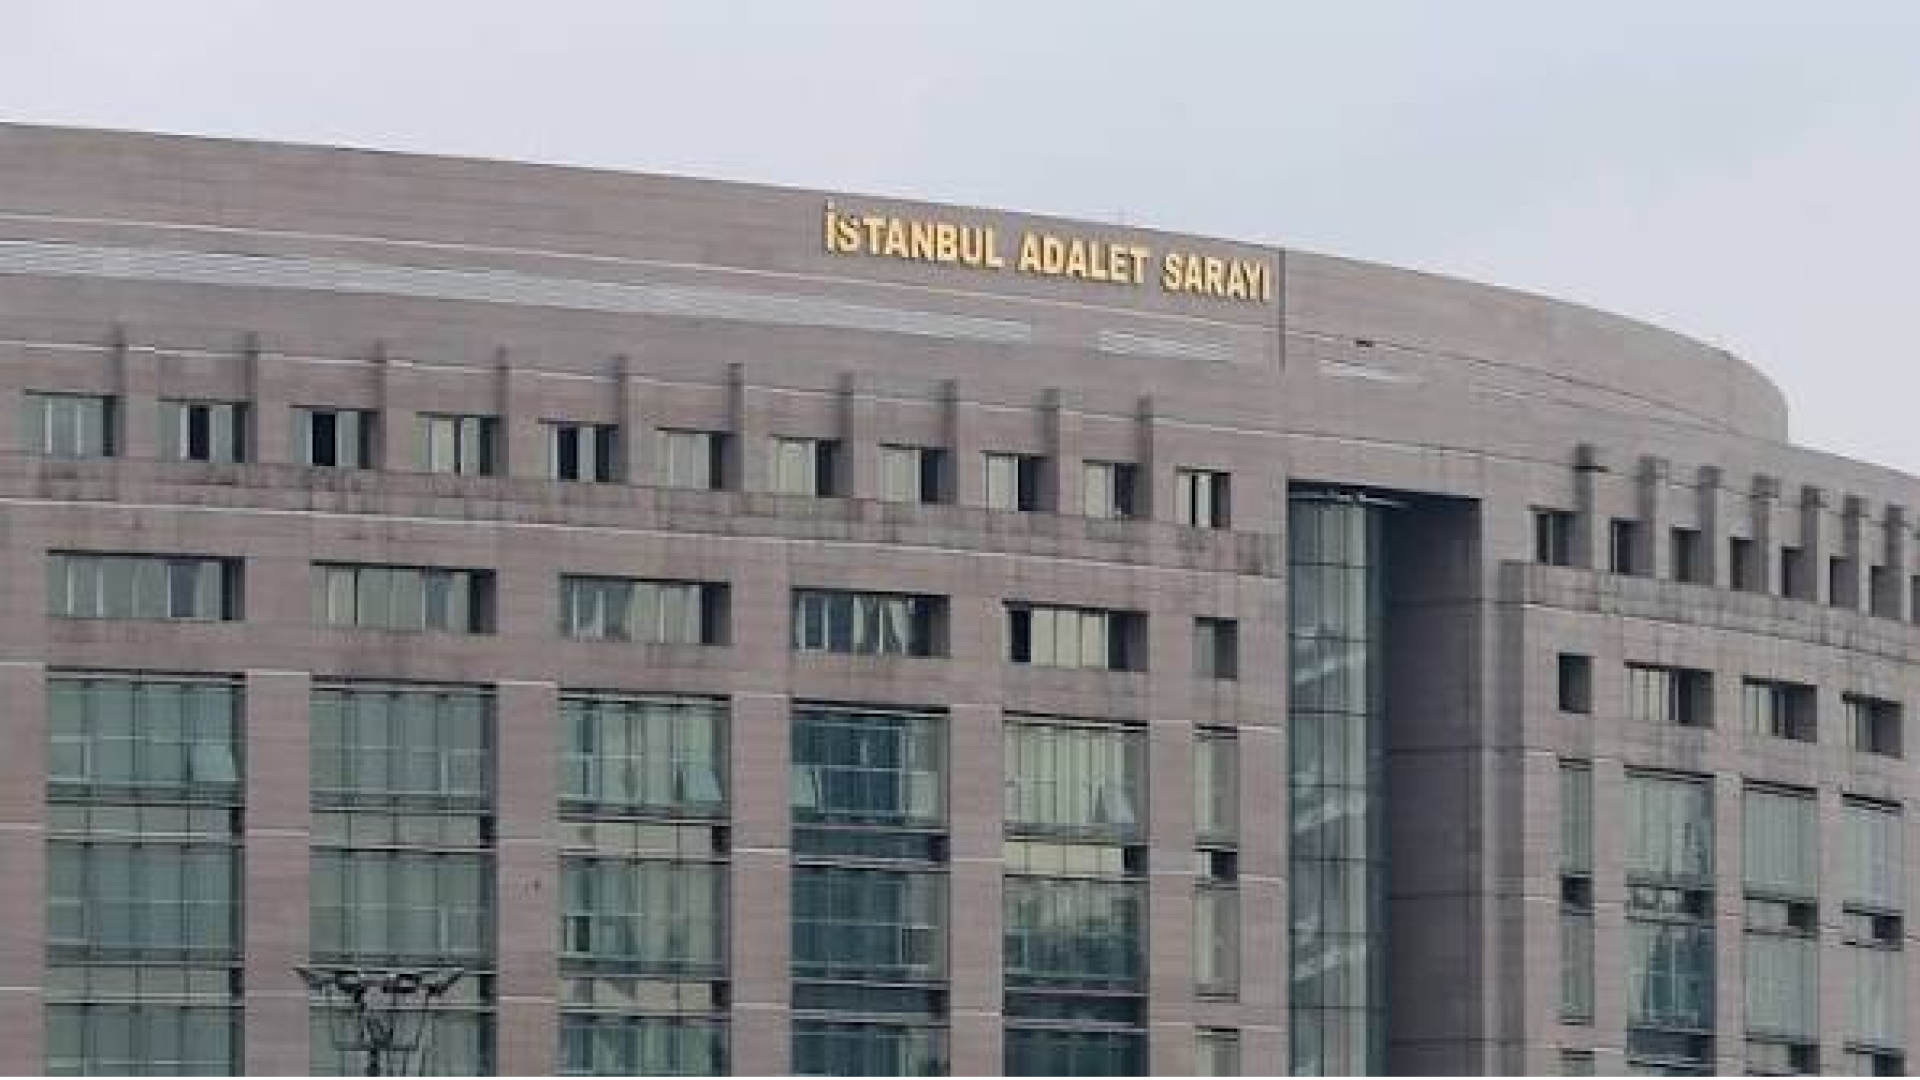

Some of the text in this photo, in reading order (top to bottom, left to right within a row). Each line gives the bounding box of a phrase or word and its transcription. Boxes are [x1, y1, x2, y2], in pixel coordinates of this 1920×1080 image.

[825, 200, 1271, 302] İSTANBUL ADALET SARAYI
